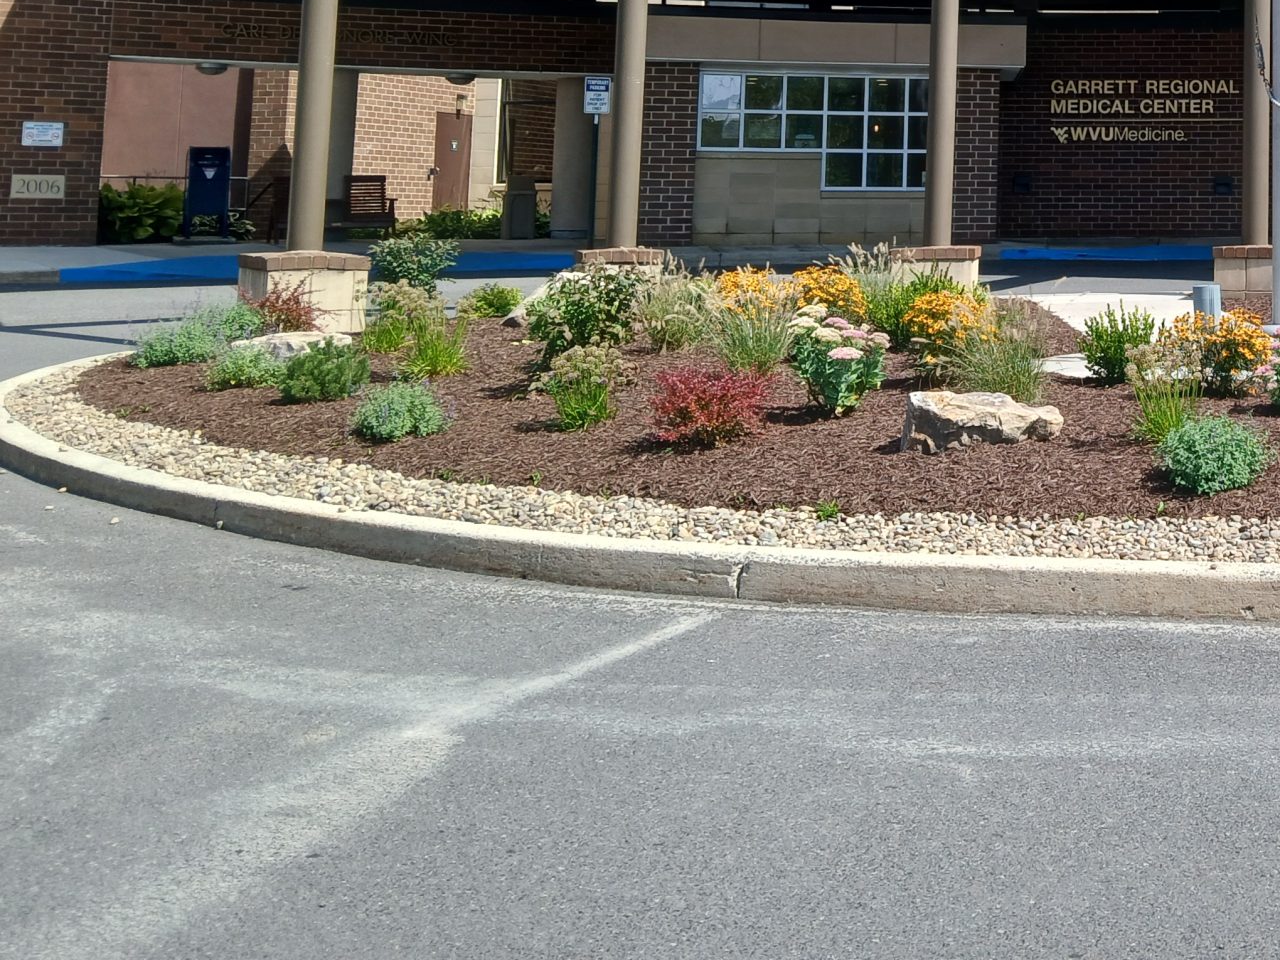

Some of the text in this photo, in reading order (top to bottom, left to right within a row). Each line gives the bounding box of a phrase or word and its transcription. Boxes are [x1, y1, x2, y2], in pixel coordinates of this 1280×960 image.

[222, 24, 268, 38] CARL
[405, 31, 457, 46] WING
[1050, 79, 1239, 95] GARRETT REGIONAL
[1050, 99, 1214, 114] MEDICAL CENTER
[15, 178, 60, 194] 2006
